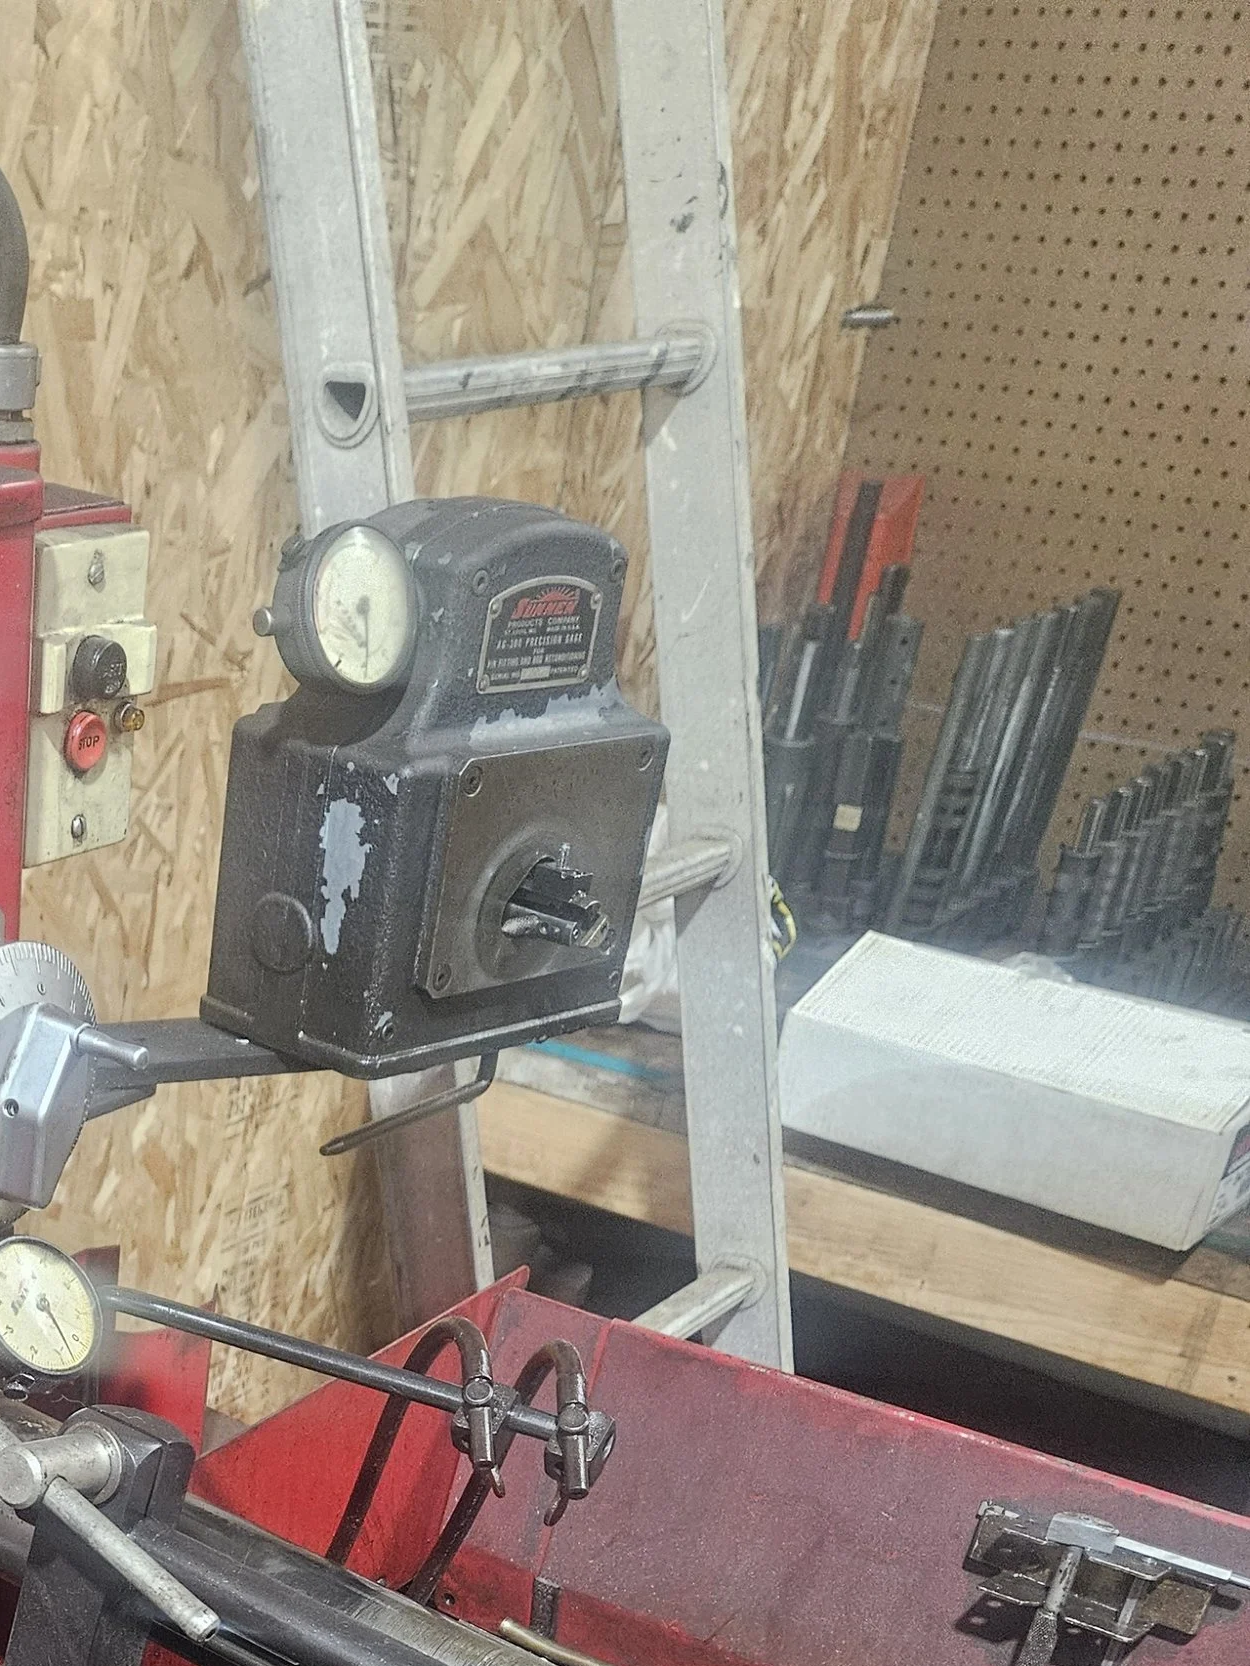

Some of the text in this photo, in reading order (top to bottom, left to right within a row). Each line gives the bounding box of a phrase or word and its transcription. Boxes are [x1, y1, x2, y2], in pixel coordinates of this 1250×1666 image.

[78, 735, 100, 751] STOP
[71, 1334, 80, 1342] 0
[30, 1345, 38, 1354] 2
